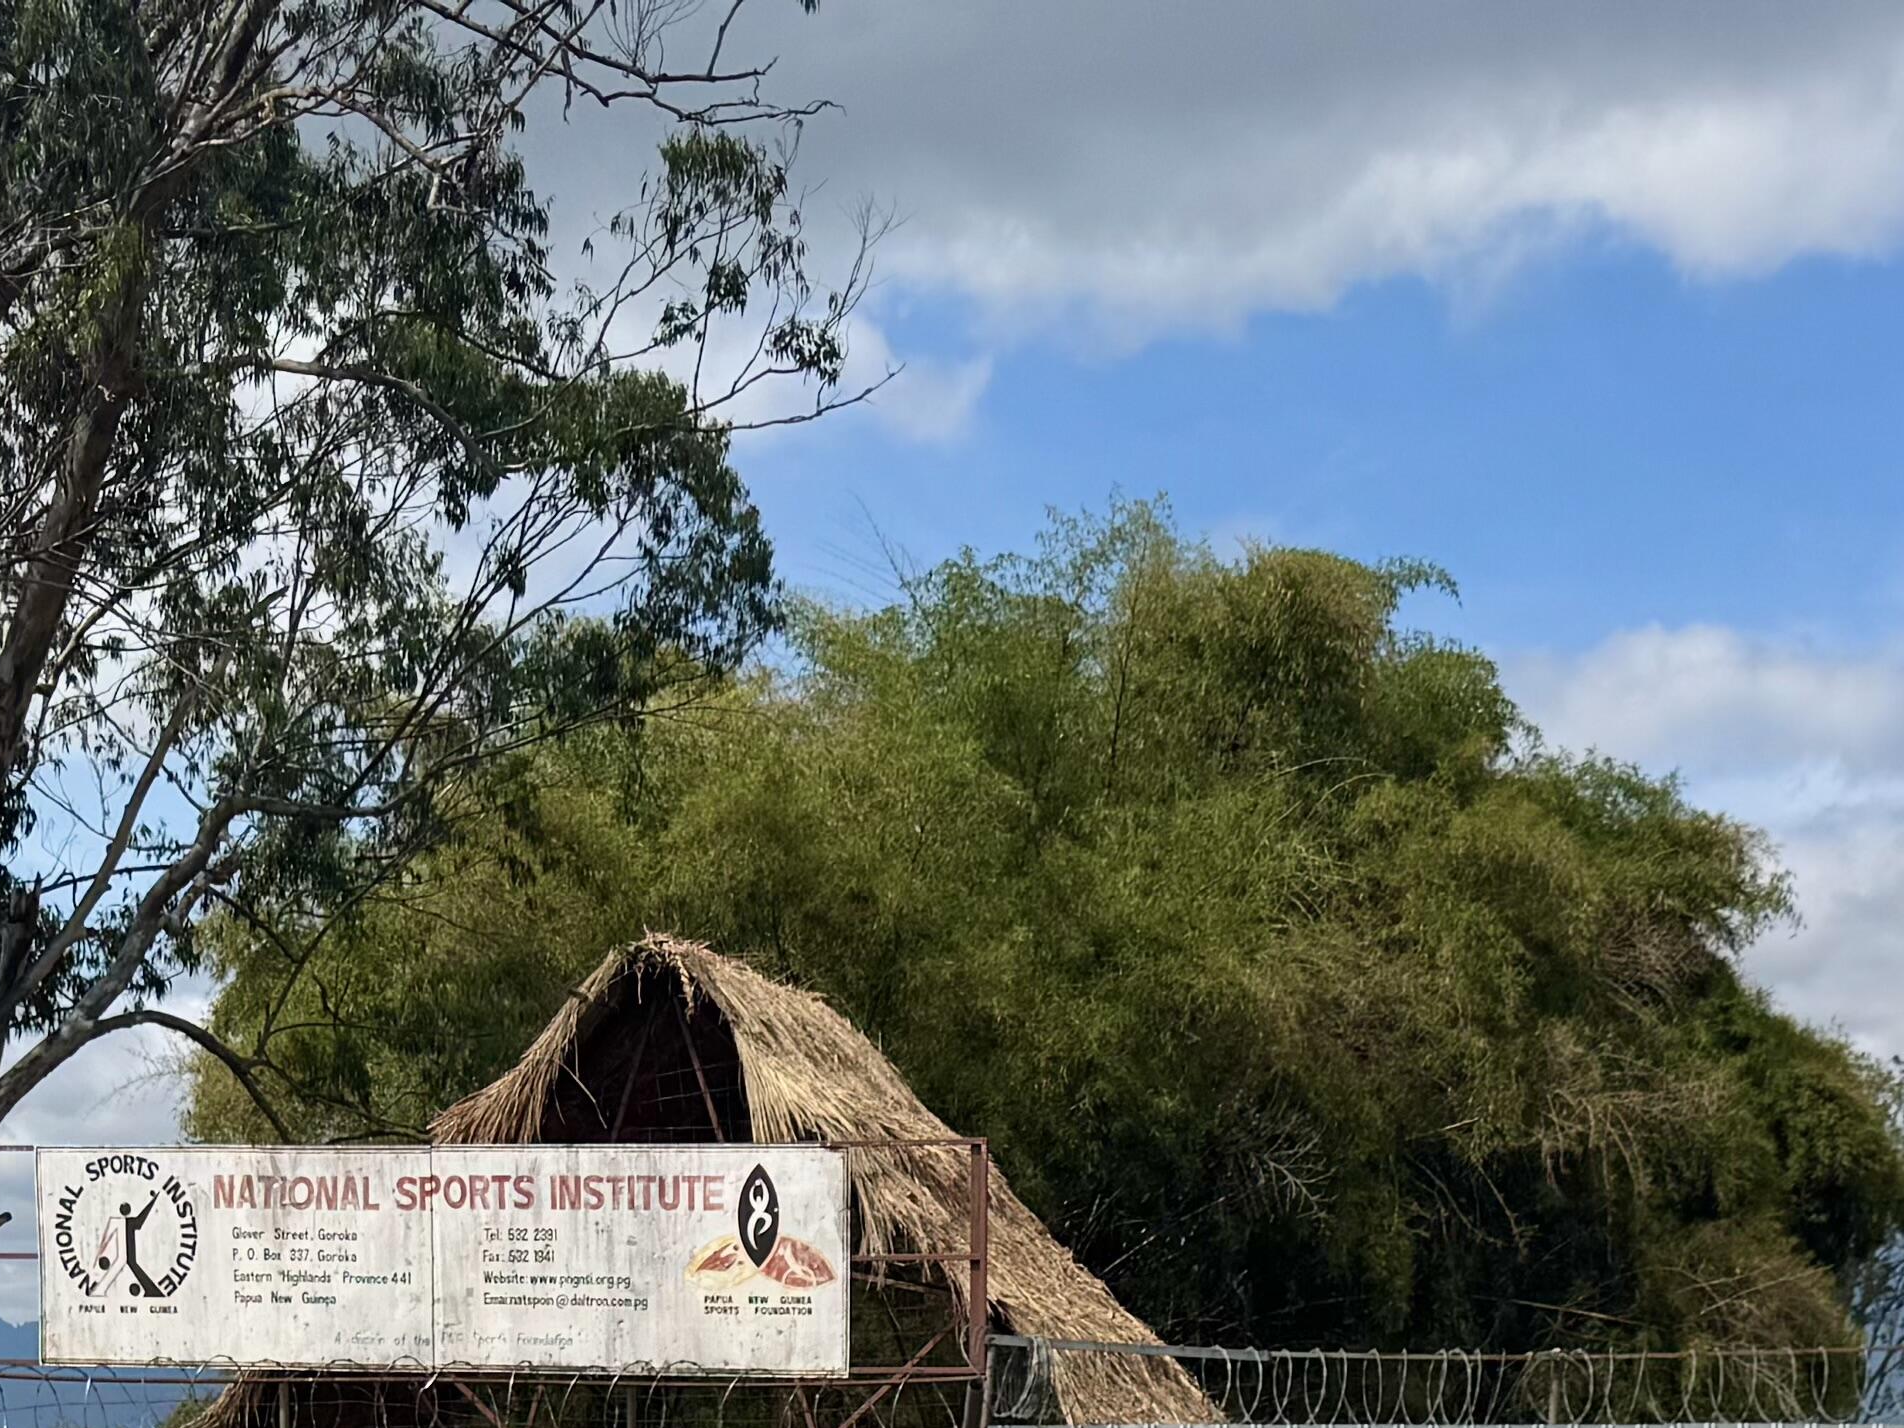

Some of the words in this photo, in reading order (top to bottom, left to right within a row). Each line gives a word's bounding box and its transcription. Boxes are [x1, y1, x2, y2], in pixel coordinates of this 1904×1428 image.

[213, 1174, 380, 1211] NATIONAL
[395, 1174, 535, 1212] SPORTS
[550, 1174, 725, 1211] INSTITUTE
[55, 1185, 96, 1297] NATIONAL
[85, 1154, 159, 1182] SPORTS
[157, 1175, 198, 1297] INSTITUTE
[317, 1228, 358, 1241] Goroka
[507, 1227, 529, 1241] 532
[317, 1249, 357, 1263] Goroka
[508, 1249, 529, 1263] 532
[233, 1268, 273, 1282] Eastern
[391, 1272, 412, 1285] 441
[234, 1291, 263, 1307] Papua
[270, 1291, 293, 1304] New
[704, 1306, 740, 1315] SPORTS
[754, 1306, 813, 1316] FOUNDATION
